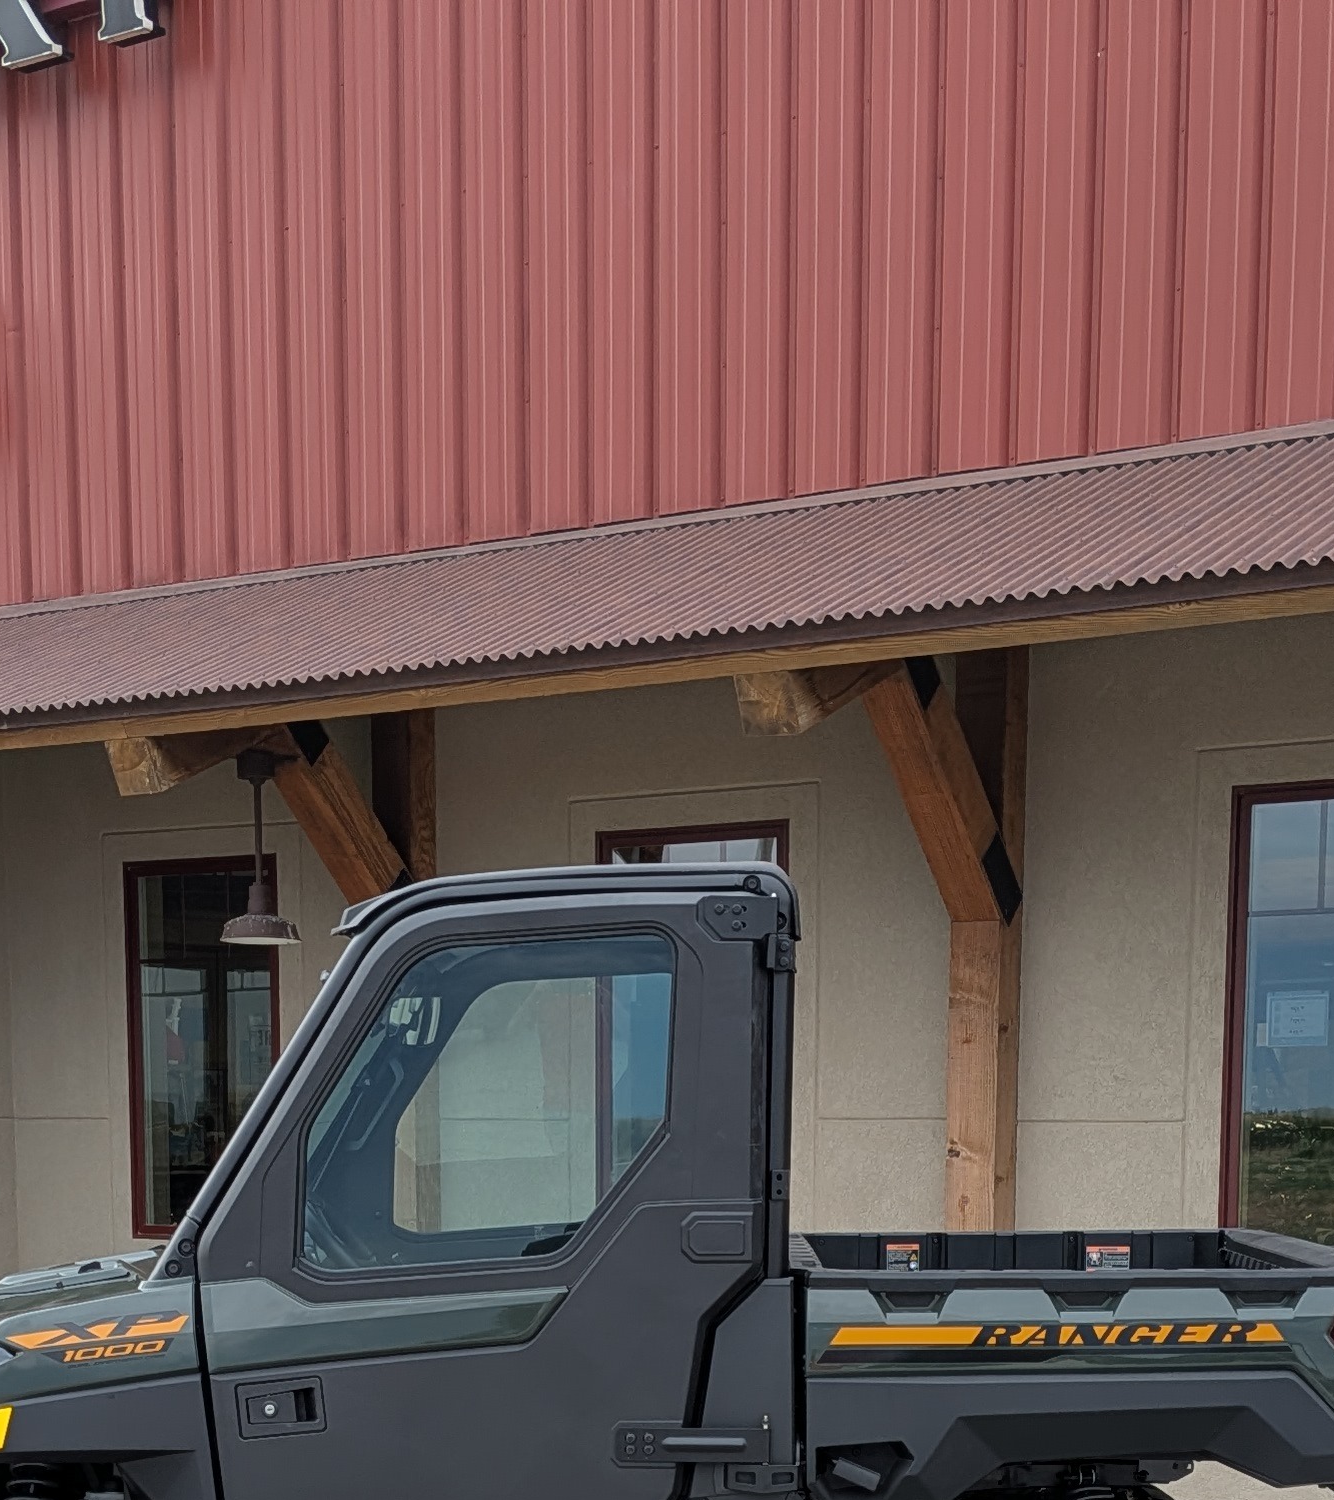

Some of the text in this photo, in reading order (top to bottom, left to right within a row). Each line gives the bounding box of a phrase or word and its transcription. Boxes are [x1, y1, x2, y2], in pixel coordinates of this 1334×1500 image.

[33, 1310, 186, 1347] XP
[969, 1322, 1259, 1348] RANGER
[63, 1340, 165, 1363] 1000
